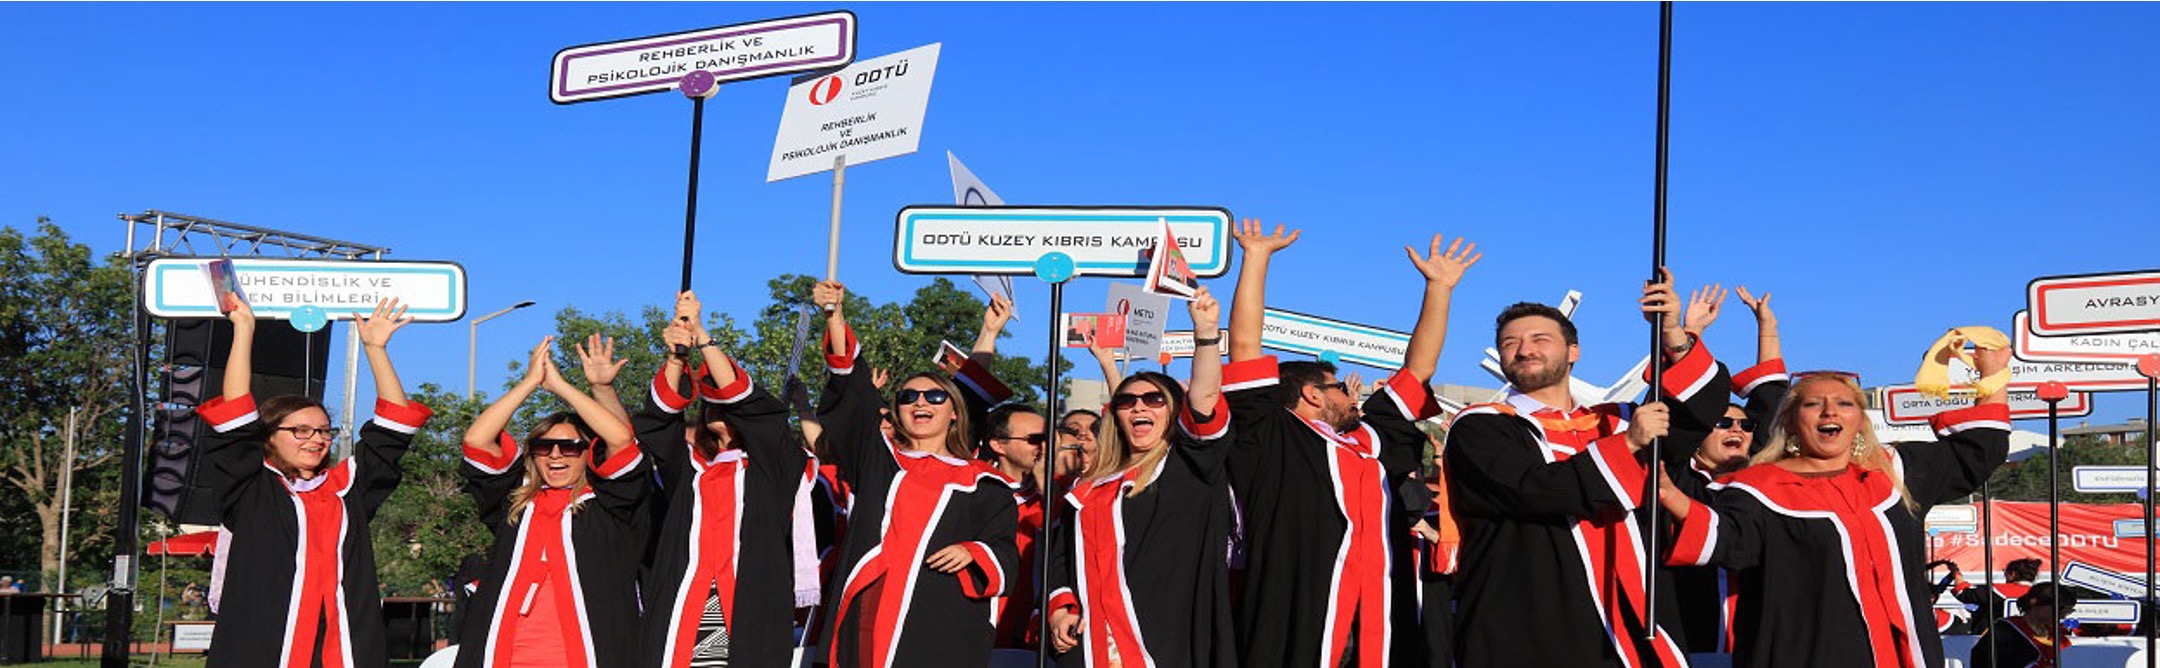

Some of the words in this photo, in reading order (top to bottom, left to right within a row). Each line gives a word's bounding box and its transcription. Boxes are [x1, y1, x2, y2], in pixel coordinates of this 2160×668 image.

[639, 38, 735, 63] REHBERLİK
[742, 36, 763, 48] VE
[587, 61, 688, 84] PSİKOLOJİK
[695, 45, 815, 70] DANIŞMANLIK
[855, 58, 909, 86] ODTÜ
[820, 112, 877, 132] REHBERLİK
[839, 128, 853, 138] VE
[922, 231, 971, 246] ODTÜ
[978, 235, 1036, 247] KUZEY
[1042, 236, 1103, 248] KIBRIS
[1111, 236, 1202, 248] KAMPSU
[241, 272, 361, 288] ÜHENDİSLİK
[369, 277, 392, 288] VE
[248, 292, 273, 303] EN
[283, 291, 379, 304] BİLİMLERİ
[2070, 337, 2121, 347] KADIN
[1902, 400, 1931, 409] ORTA
